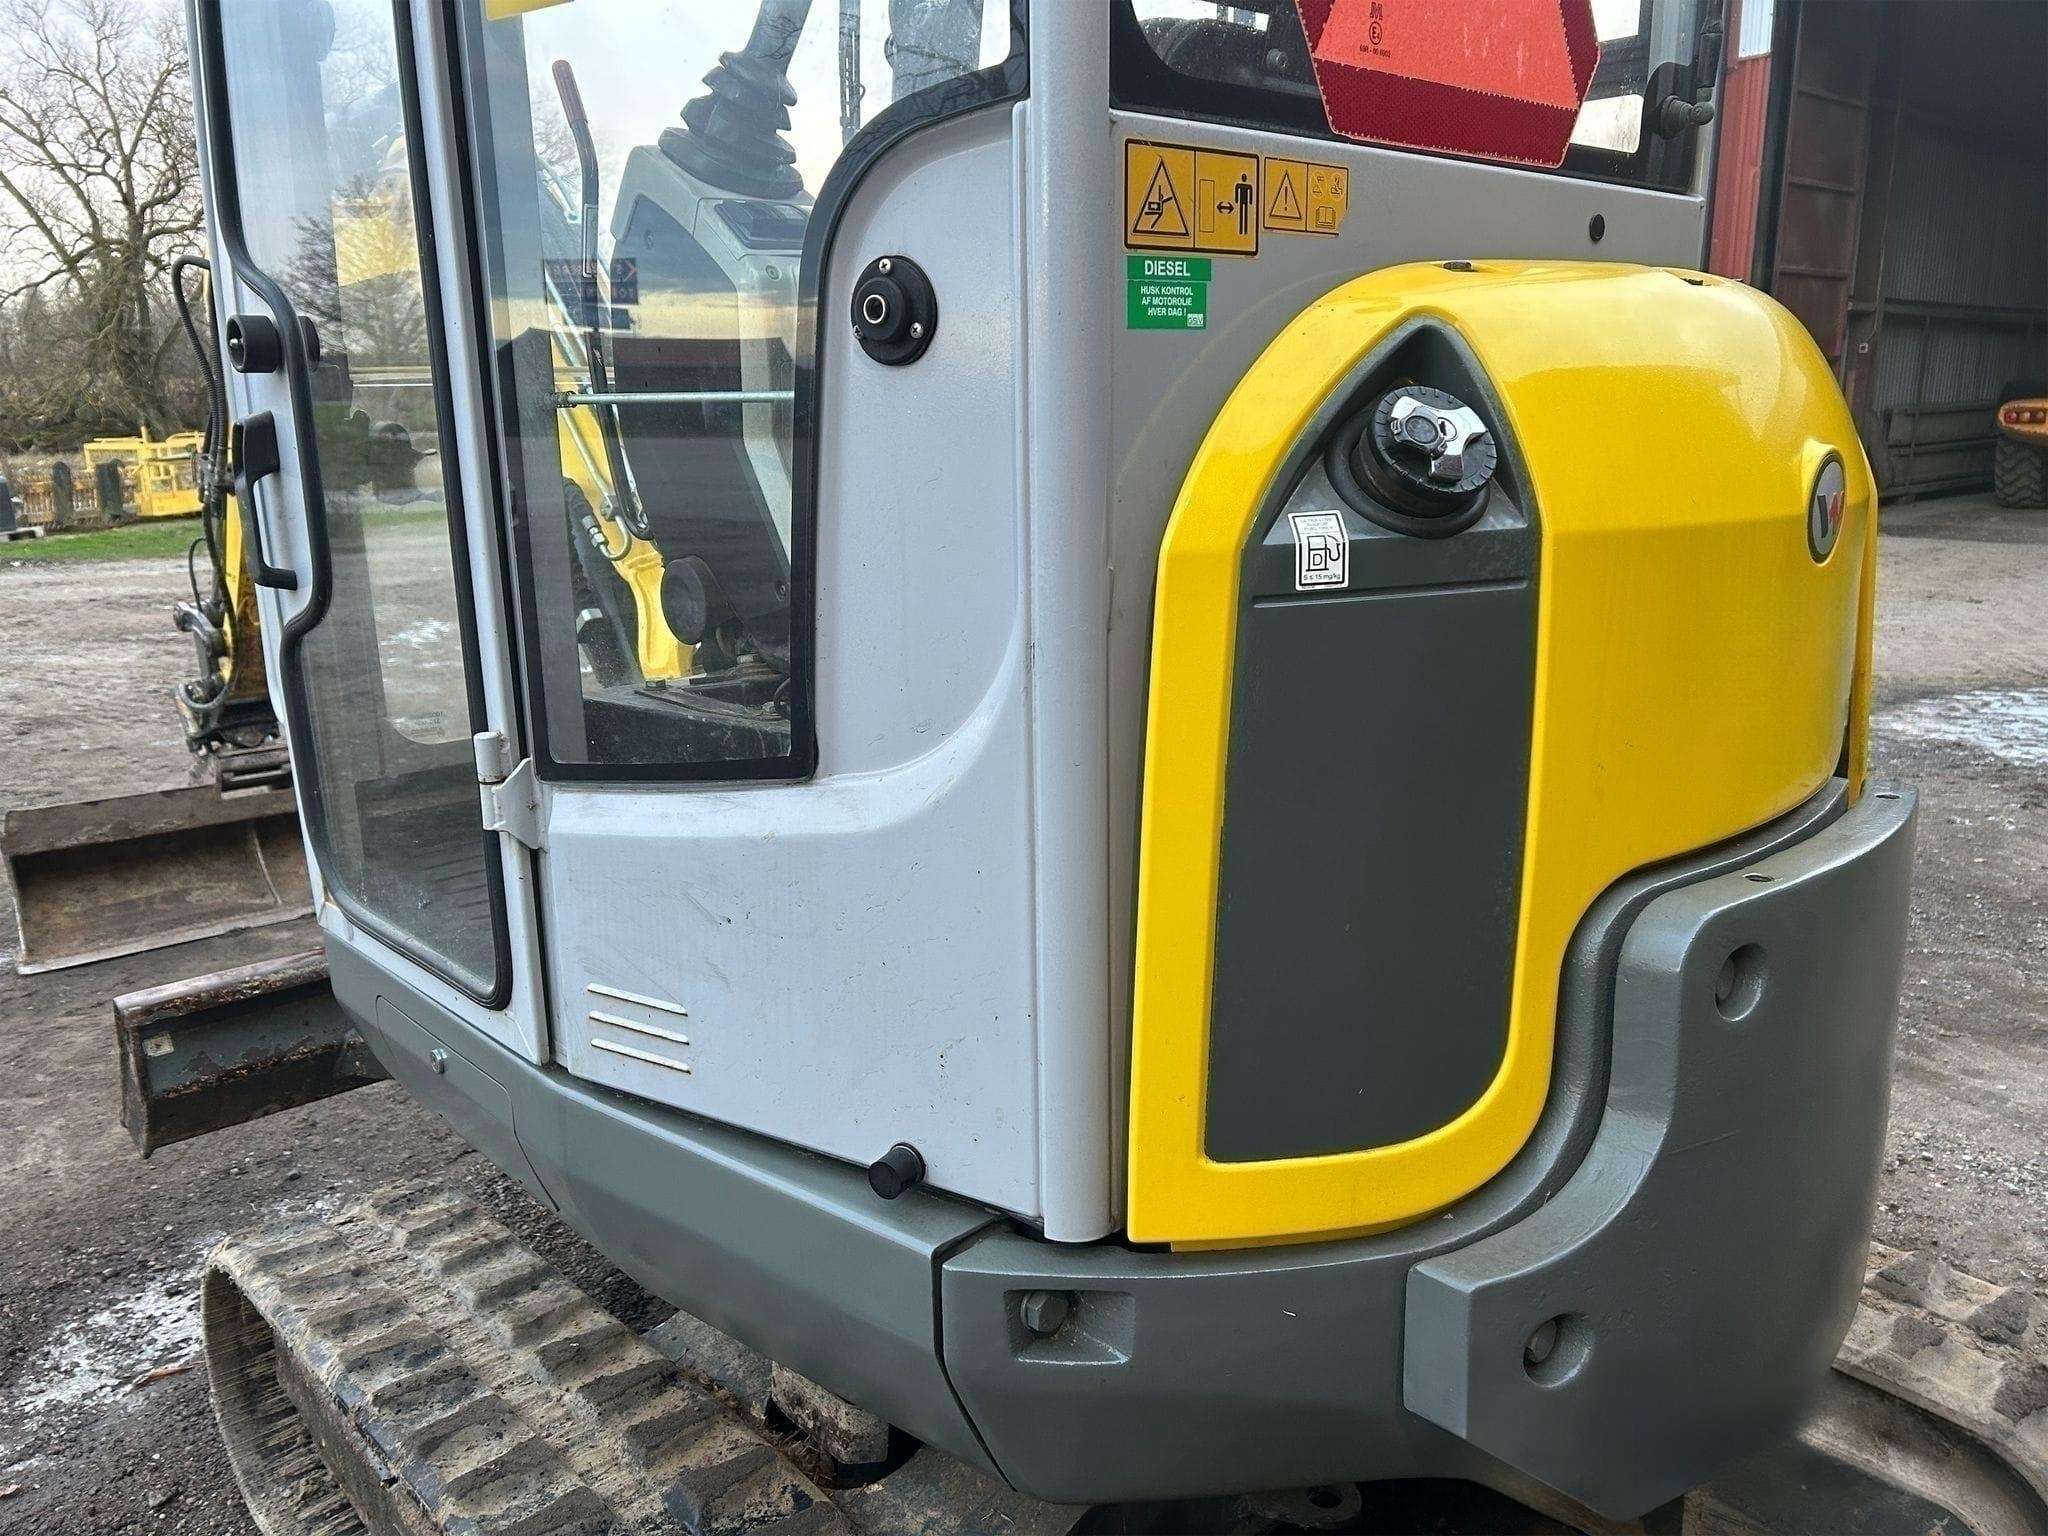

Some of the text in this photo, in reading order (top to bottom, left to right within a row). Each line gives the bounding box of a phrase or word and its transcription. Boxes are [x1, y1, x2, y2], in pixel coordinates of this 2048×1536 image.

[1144, 260, 1191, 276] DIESEL
[1140, 286, 1194, 295] HUSK KONTROL
[1141, 297, 1193, 306] AF MOTOROLIE
[1147, 307, 1167, 316] HVER
[1167, 307, 1183, 316] DAG
[1312, 553, 1323, 566] D
